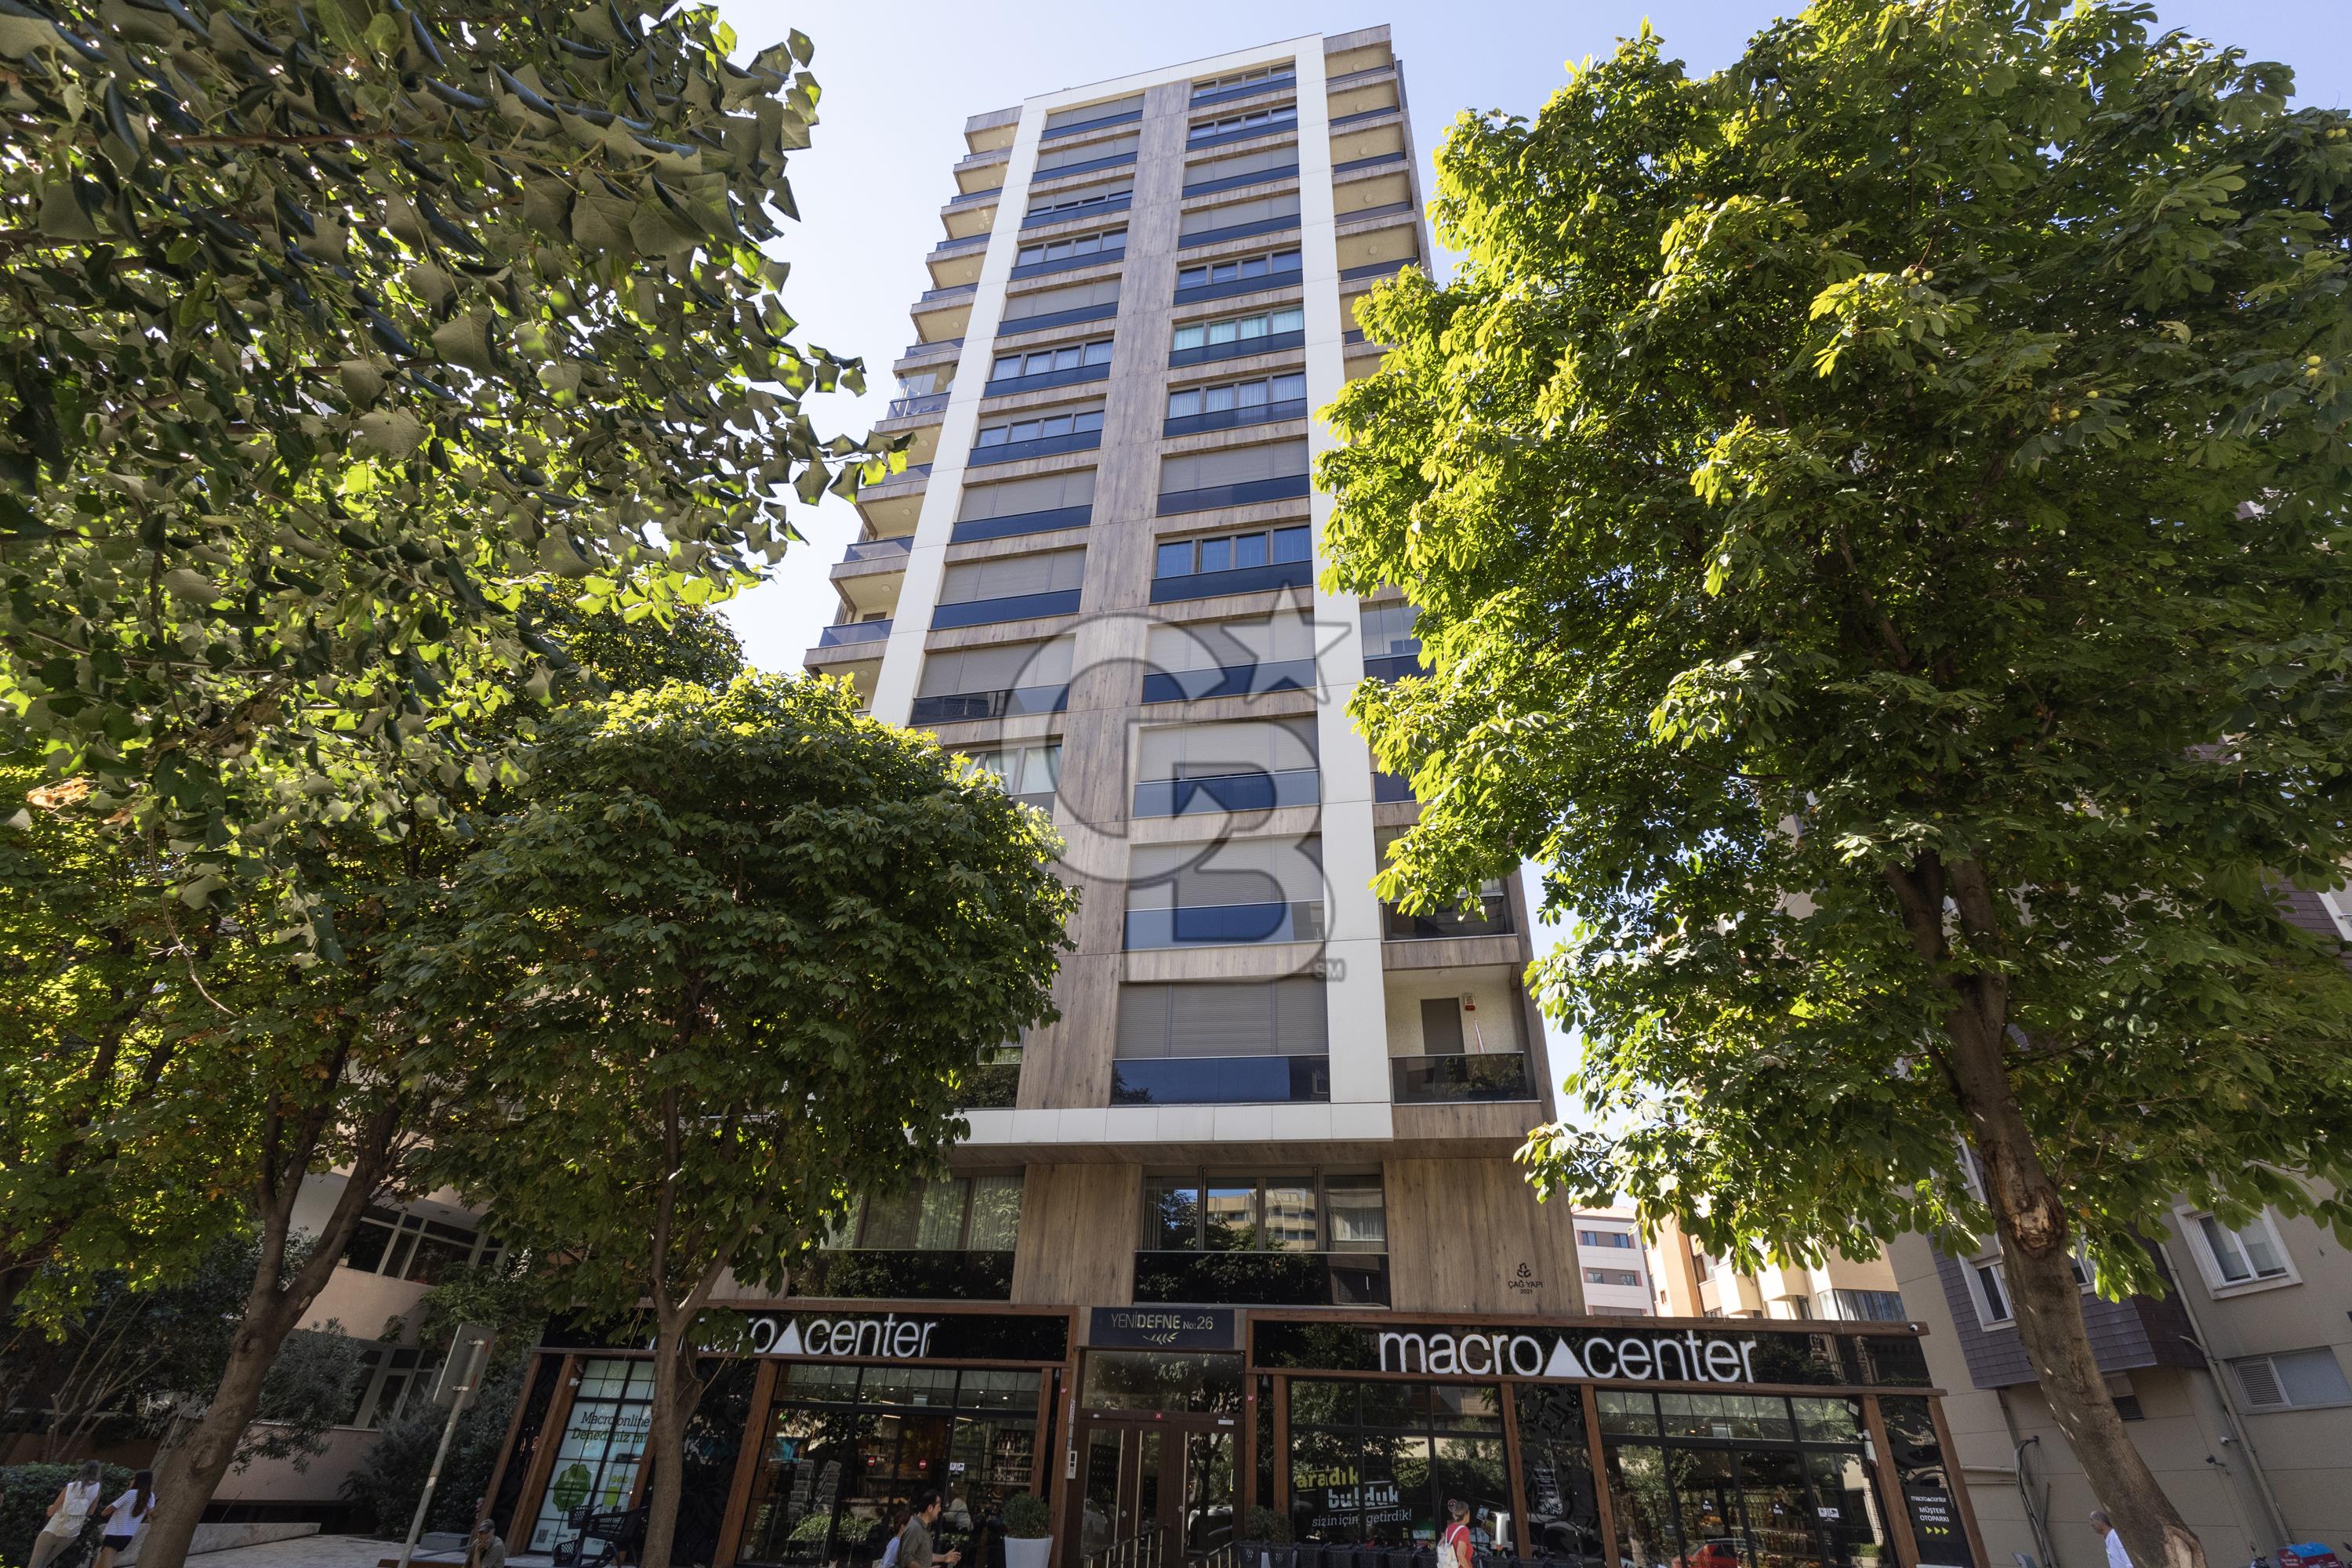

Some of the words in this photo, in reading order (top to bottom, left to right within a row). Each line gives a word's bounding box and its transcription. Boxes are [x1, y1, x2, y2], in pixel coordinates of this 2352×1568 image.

[804, 1313, 936, 1357] center
[1378, 1332, 1543, 1377] macro
[1583, 1330, 1756, 1383] center
[1296, 1465, 1359, 1488] aradık
[1312, 1515, 1338, 1527] sizin
[1366, 1508, 1412, 1526] getirdik!
